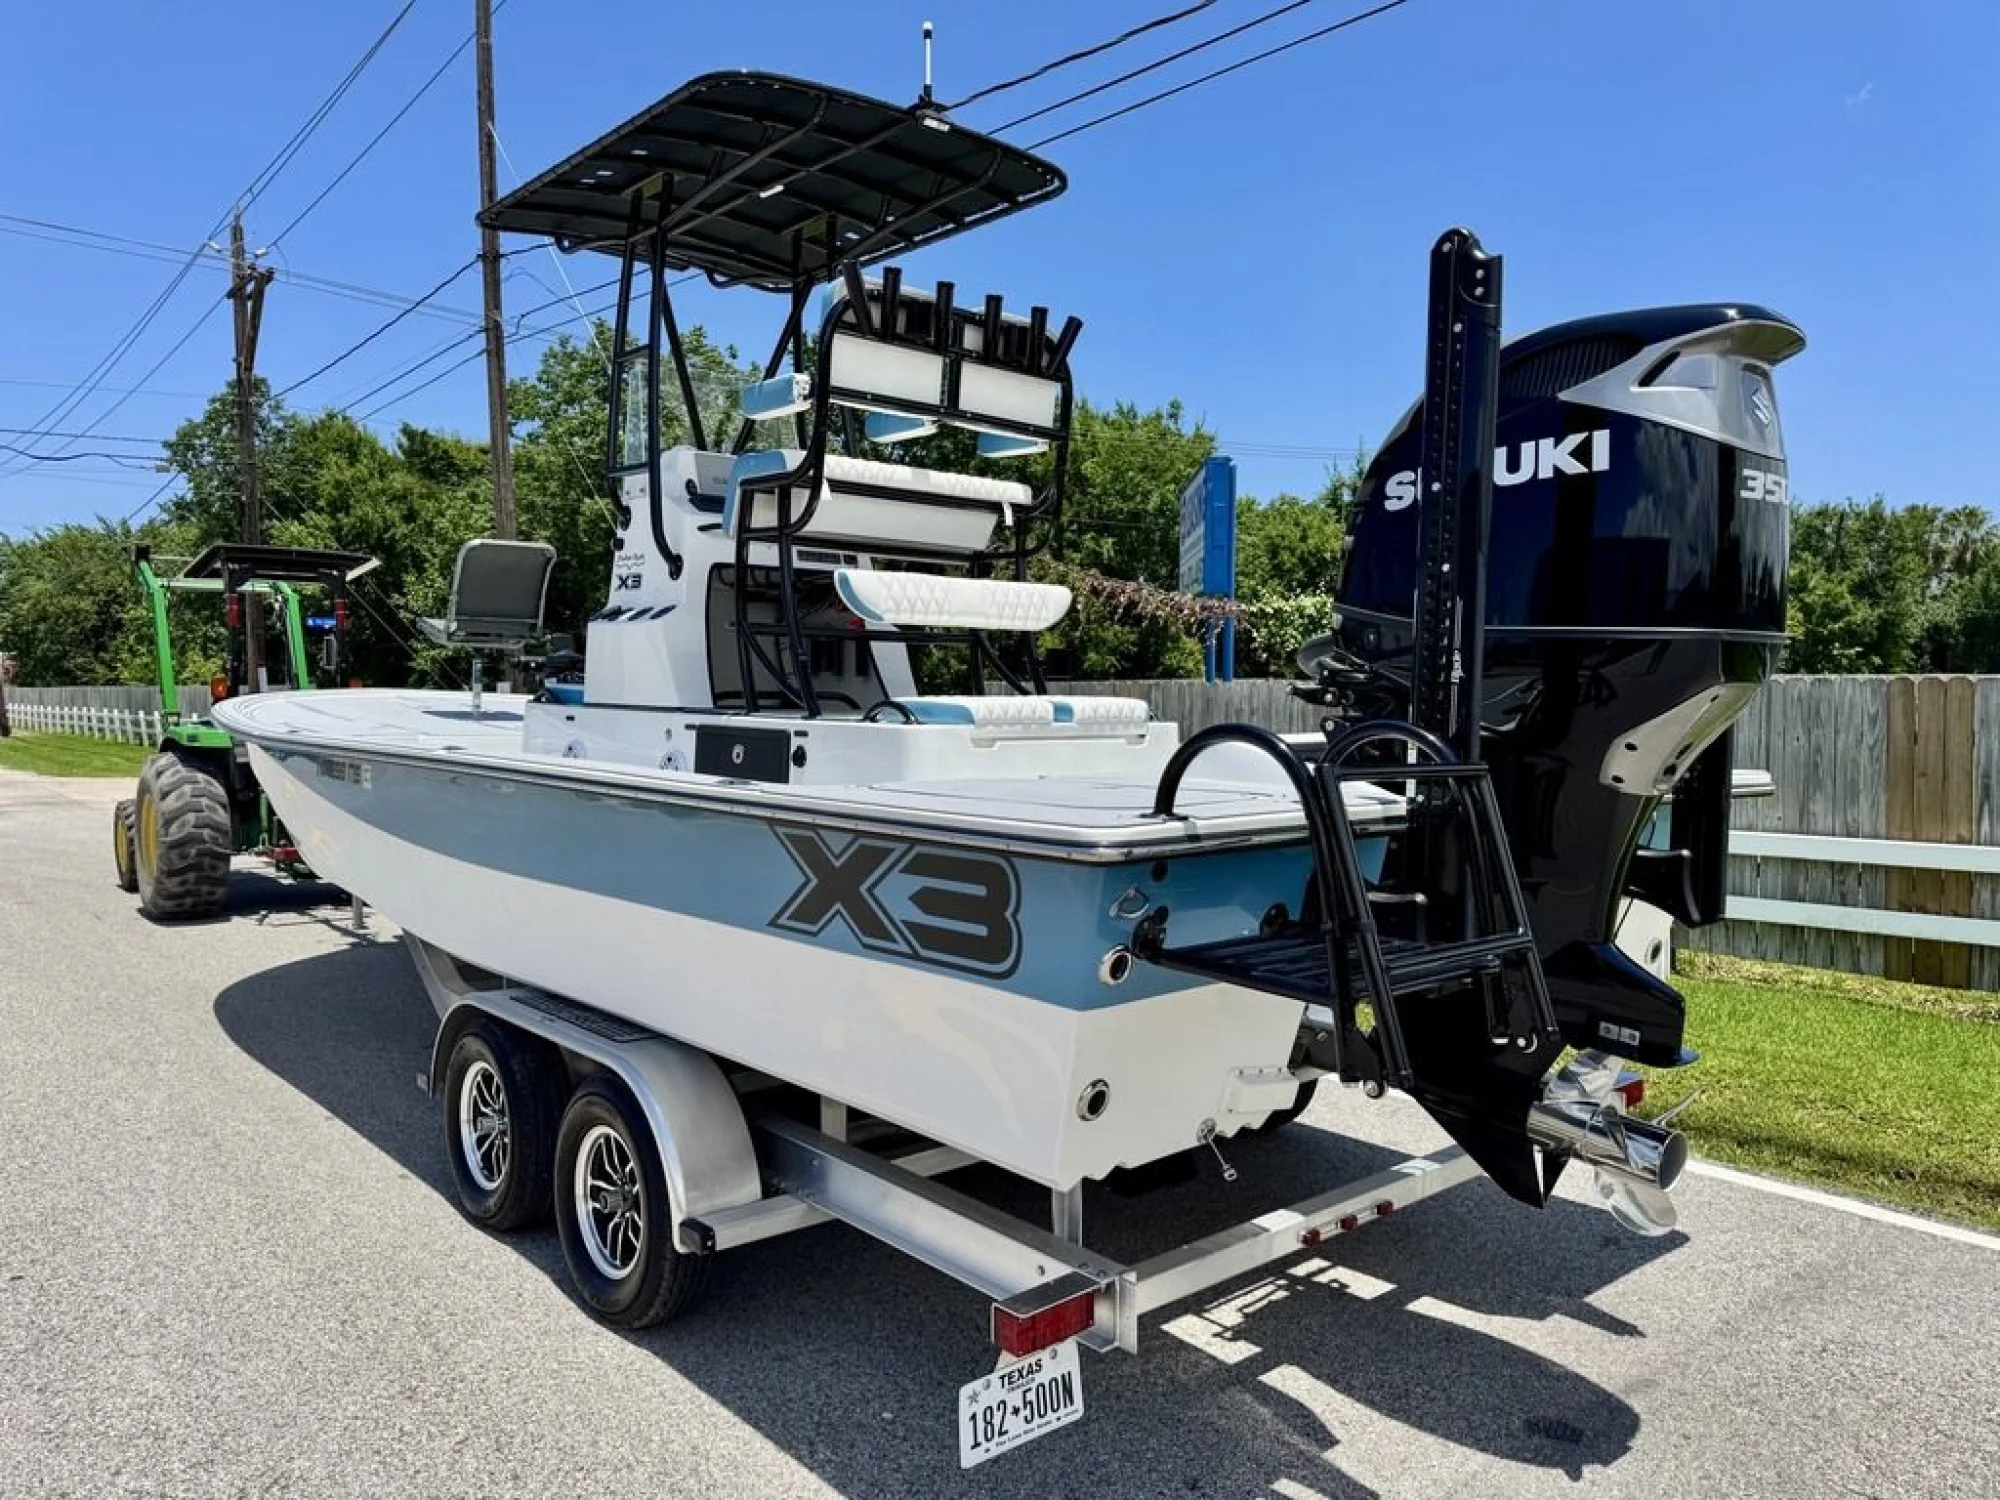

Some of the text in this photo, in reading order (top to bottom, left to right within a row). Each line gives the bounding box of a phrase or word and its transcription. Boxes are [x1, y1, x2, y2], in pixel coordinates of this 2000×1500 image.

[1385, 430, 1610, 512] SUKI
[615, 573, 642, 592] X3
[766, 821, 1023, 980] X3
[998, 1358, 1042, 1389] TEXAS
